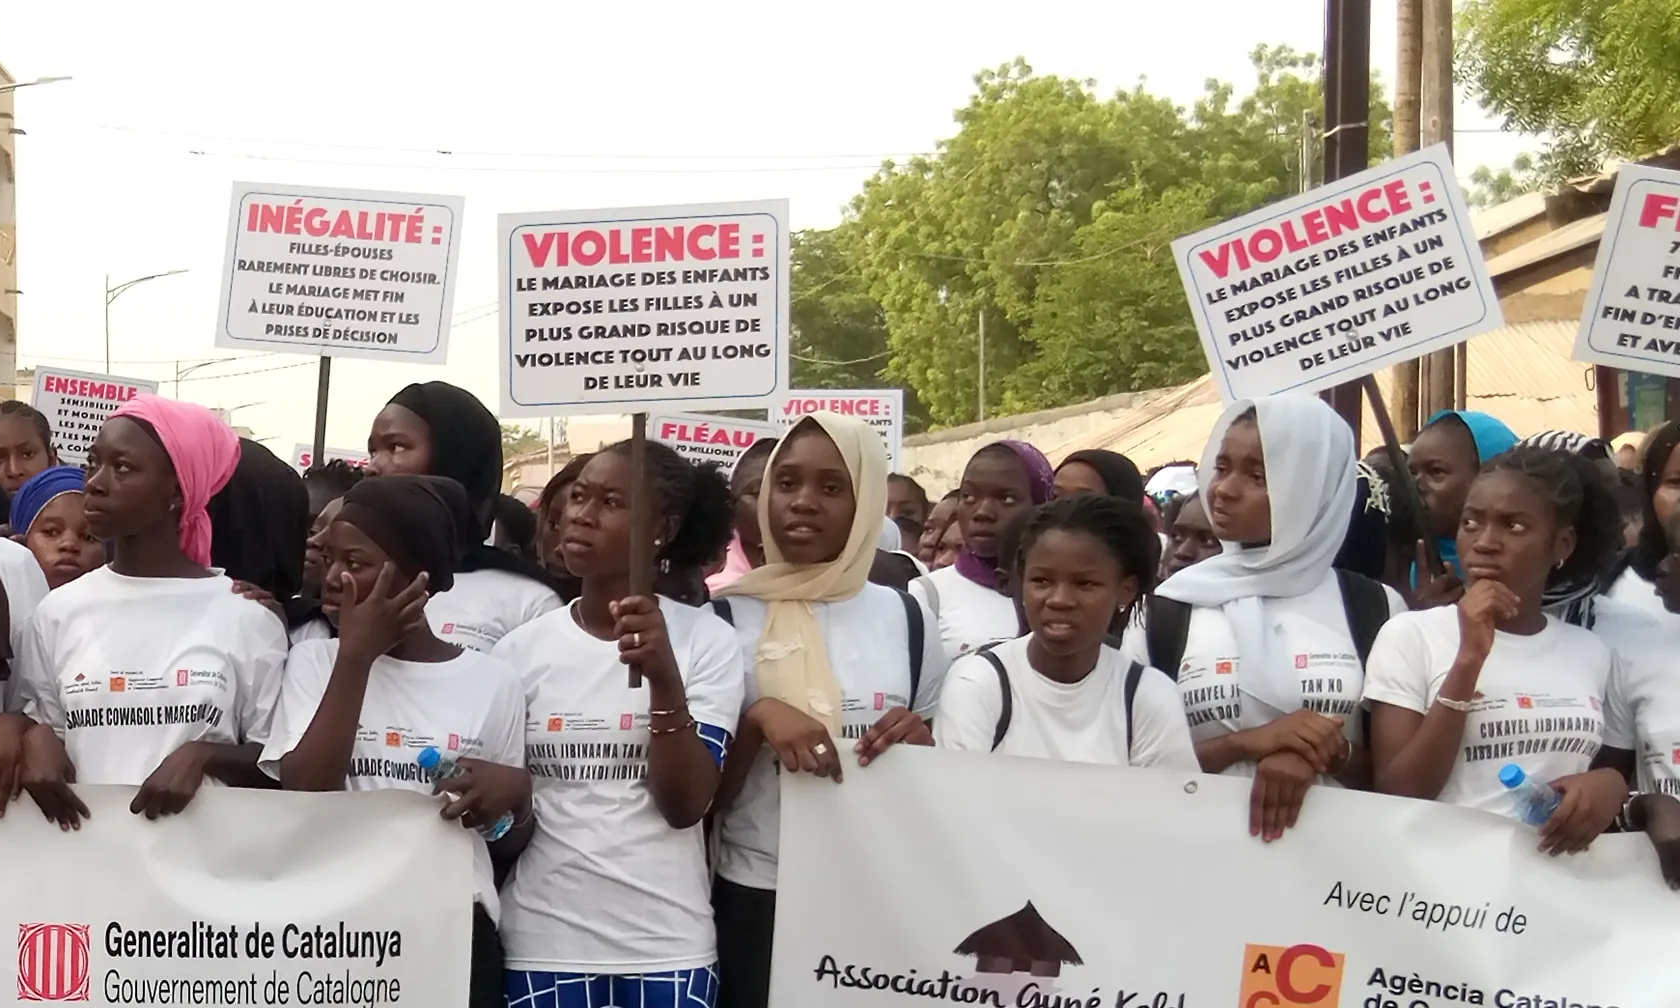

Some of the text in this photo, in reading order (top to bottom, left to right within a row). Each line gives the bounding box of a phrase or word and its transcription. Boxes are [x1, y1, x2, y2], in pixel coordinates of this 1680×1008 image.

[247, 204, 424, 243] INÉGALITÉ
[1199, 180, 1412, 278] VIOLENCE
[522, 224, 739, 268] VIOLENCE
[517, 266, 769, 291] LE MARIAGE DES ENFANTS
[529, 291, 757, 316] EXPOSE LES FILLES À UN
[1229, 257, 1454, 346] PLUS GRAND RISQUE DE
[1602, 306, 1636, 324] FIN
[266, 324, 398, 344] PRISES DE DÉCISION
[1616, 332, 1642, 348] ET
[1324, 882, 1526, 934] Avec l'appui de
[106, 922, 401, 967] Generalitat de Catalunya
[105, 970, 257, 1004] Gouvernement
[264, 970, 289, 1004] de
[814, 955, 1006, 1008] Association
[1367, 968, 1484, 1006] Agència
